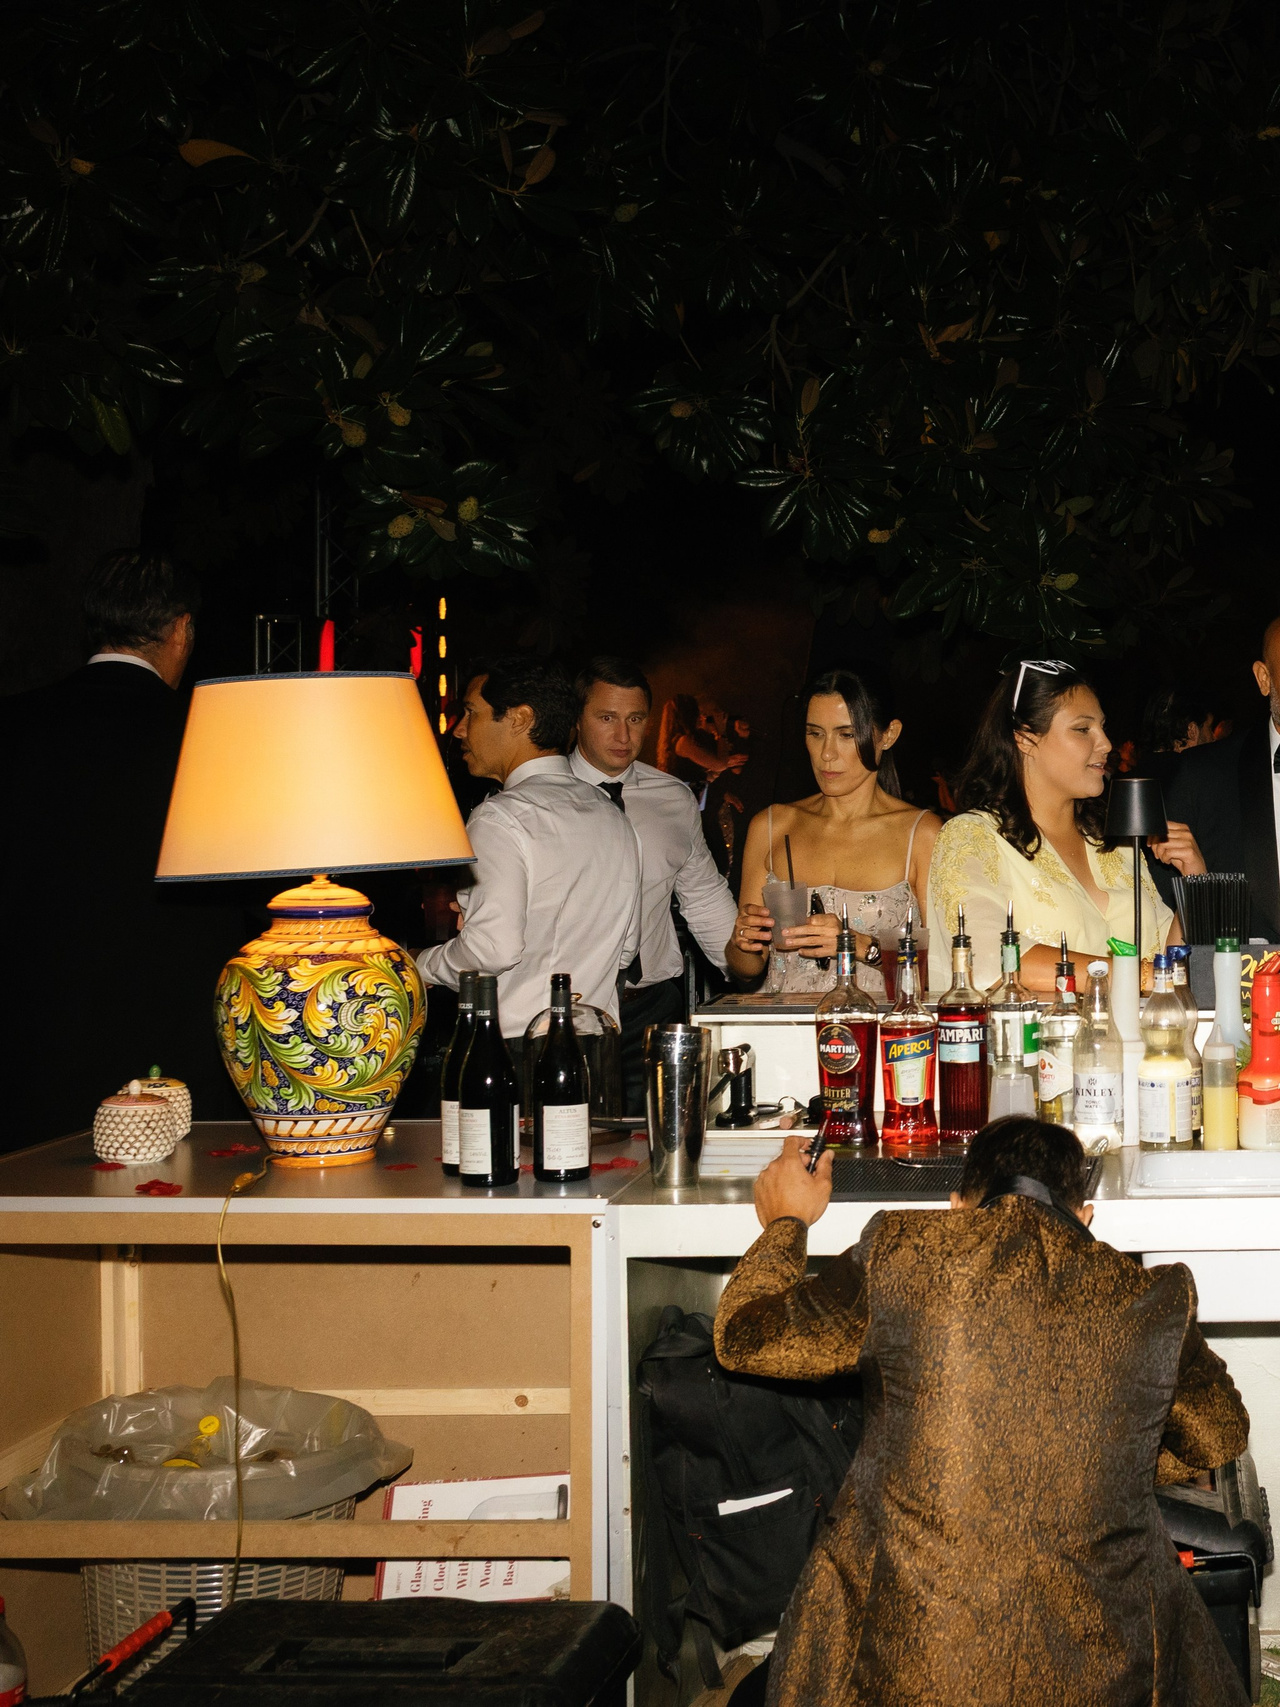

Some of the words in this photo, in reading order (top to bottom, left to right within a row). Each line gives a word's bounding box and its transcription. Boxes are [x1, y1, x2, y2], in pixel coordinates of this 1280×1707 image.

[819, 1043, 856, 1054] MARTINI
[888, 1039, 931, 1059] APEROL
[824, 1087, 851, 1098] BITTER
[1075, 1087, 1113, 1096] KINLEY
[418, 1499, 433, 1520] ing
